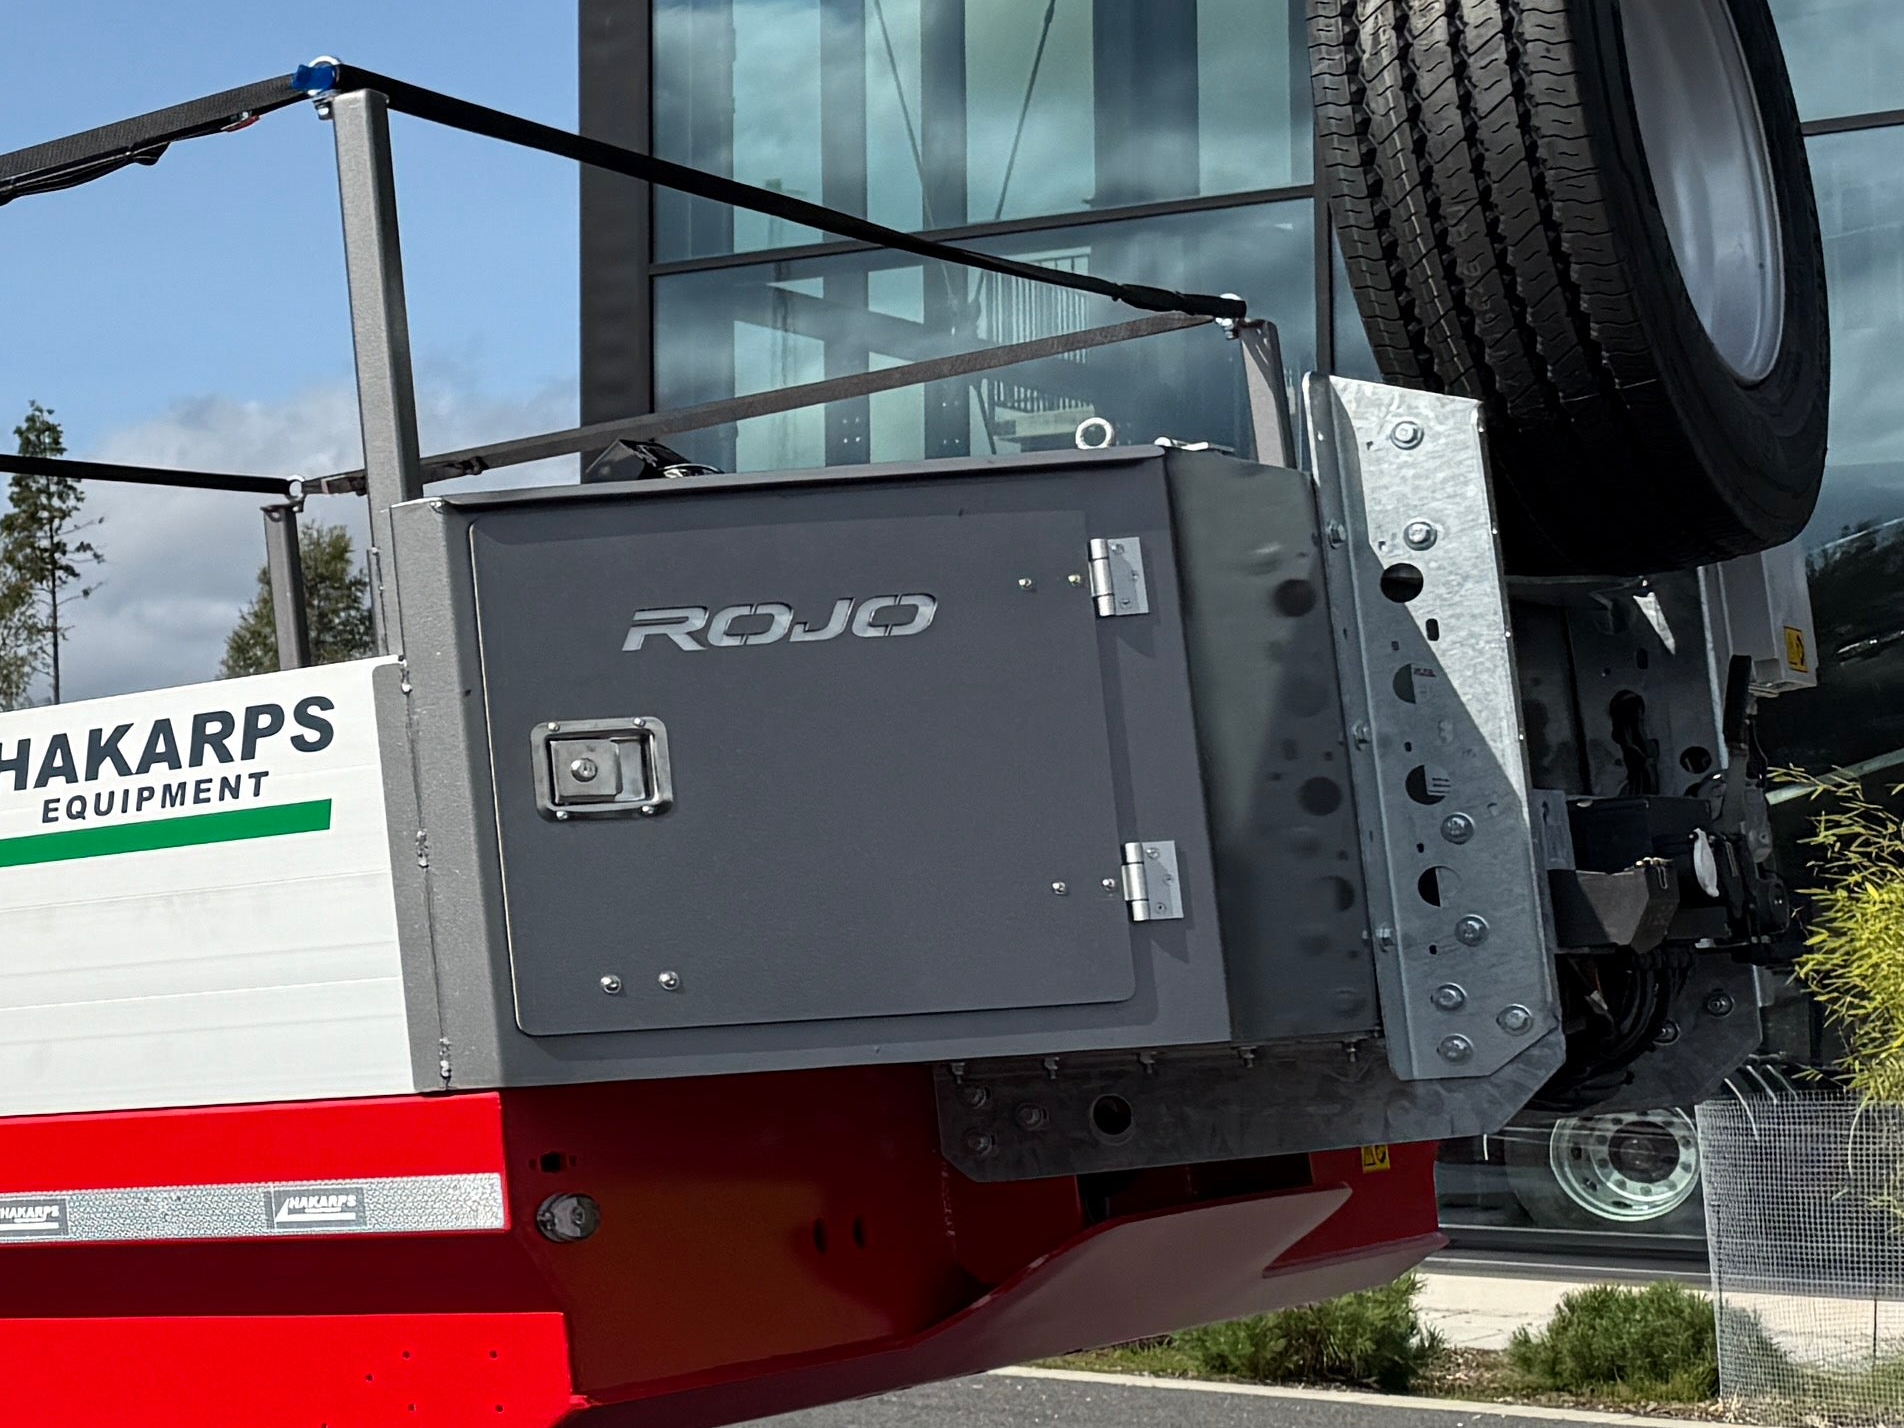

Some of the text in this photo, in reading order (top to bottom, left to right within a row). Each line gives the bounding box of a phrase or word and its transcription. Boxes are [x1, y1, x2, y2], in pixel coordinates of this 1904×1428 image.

[622, 592, 938, 652] ROJO
[42, 771, 269, 823] EQUIPMENT
[0, 1205, 59, 1218] HAKARPS
[289, 1195, 357, 1209] HAKARPS
